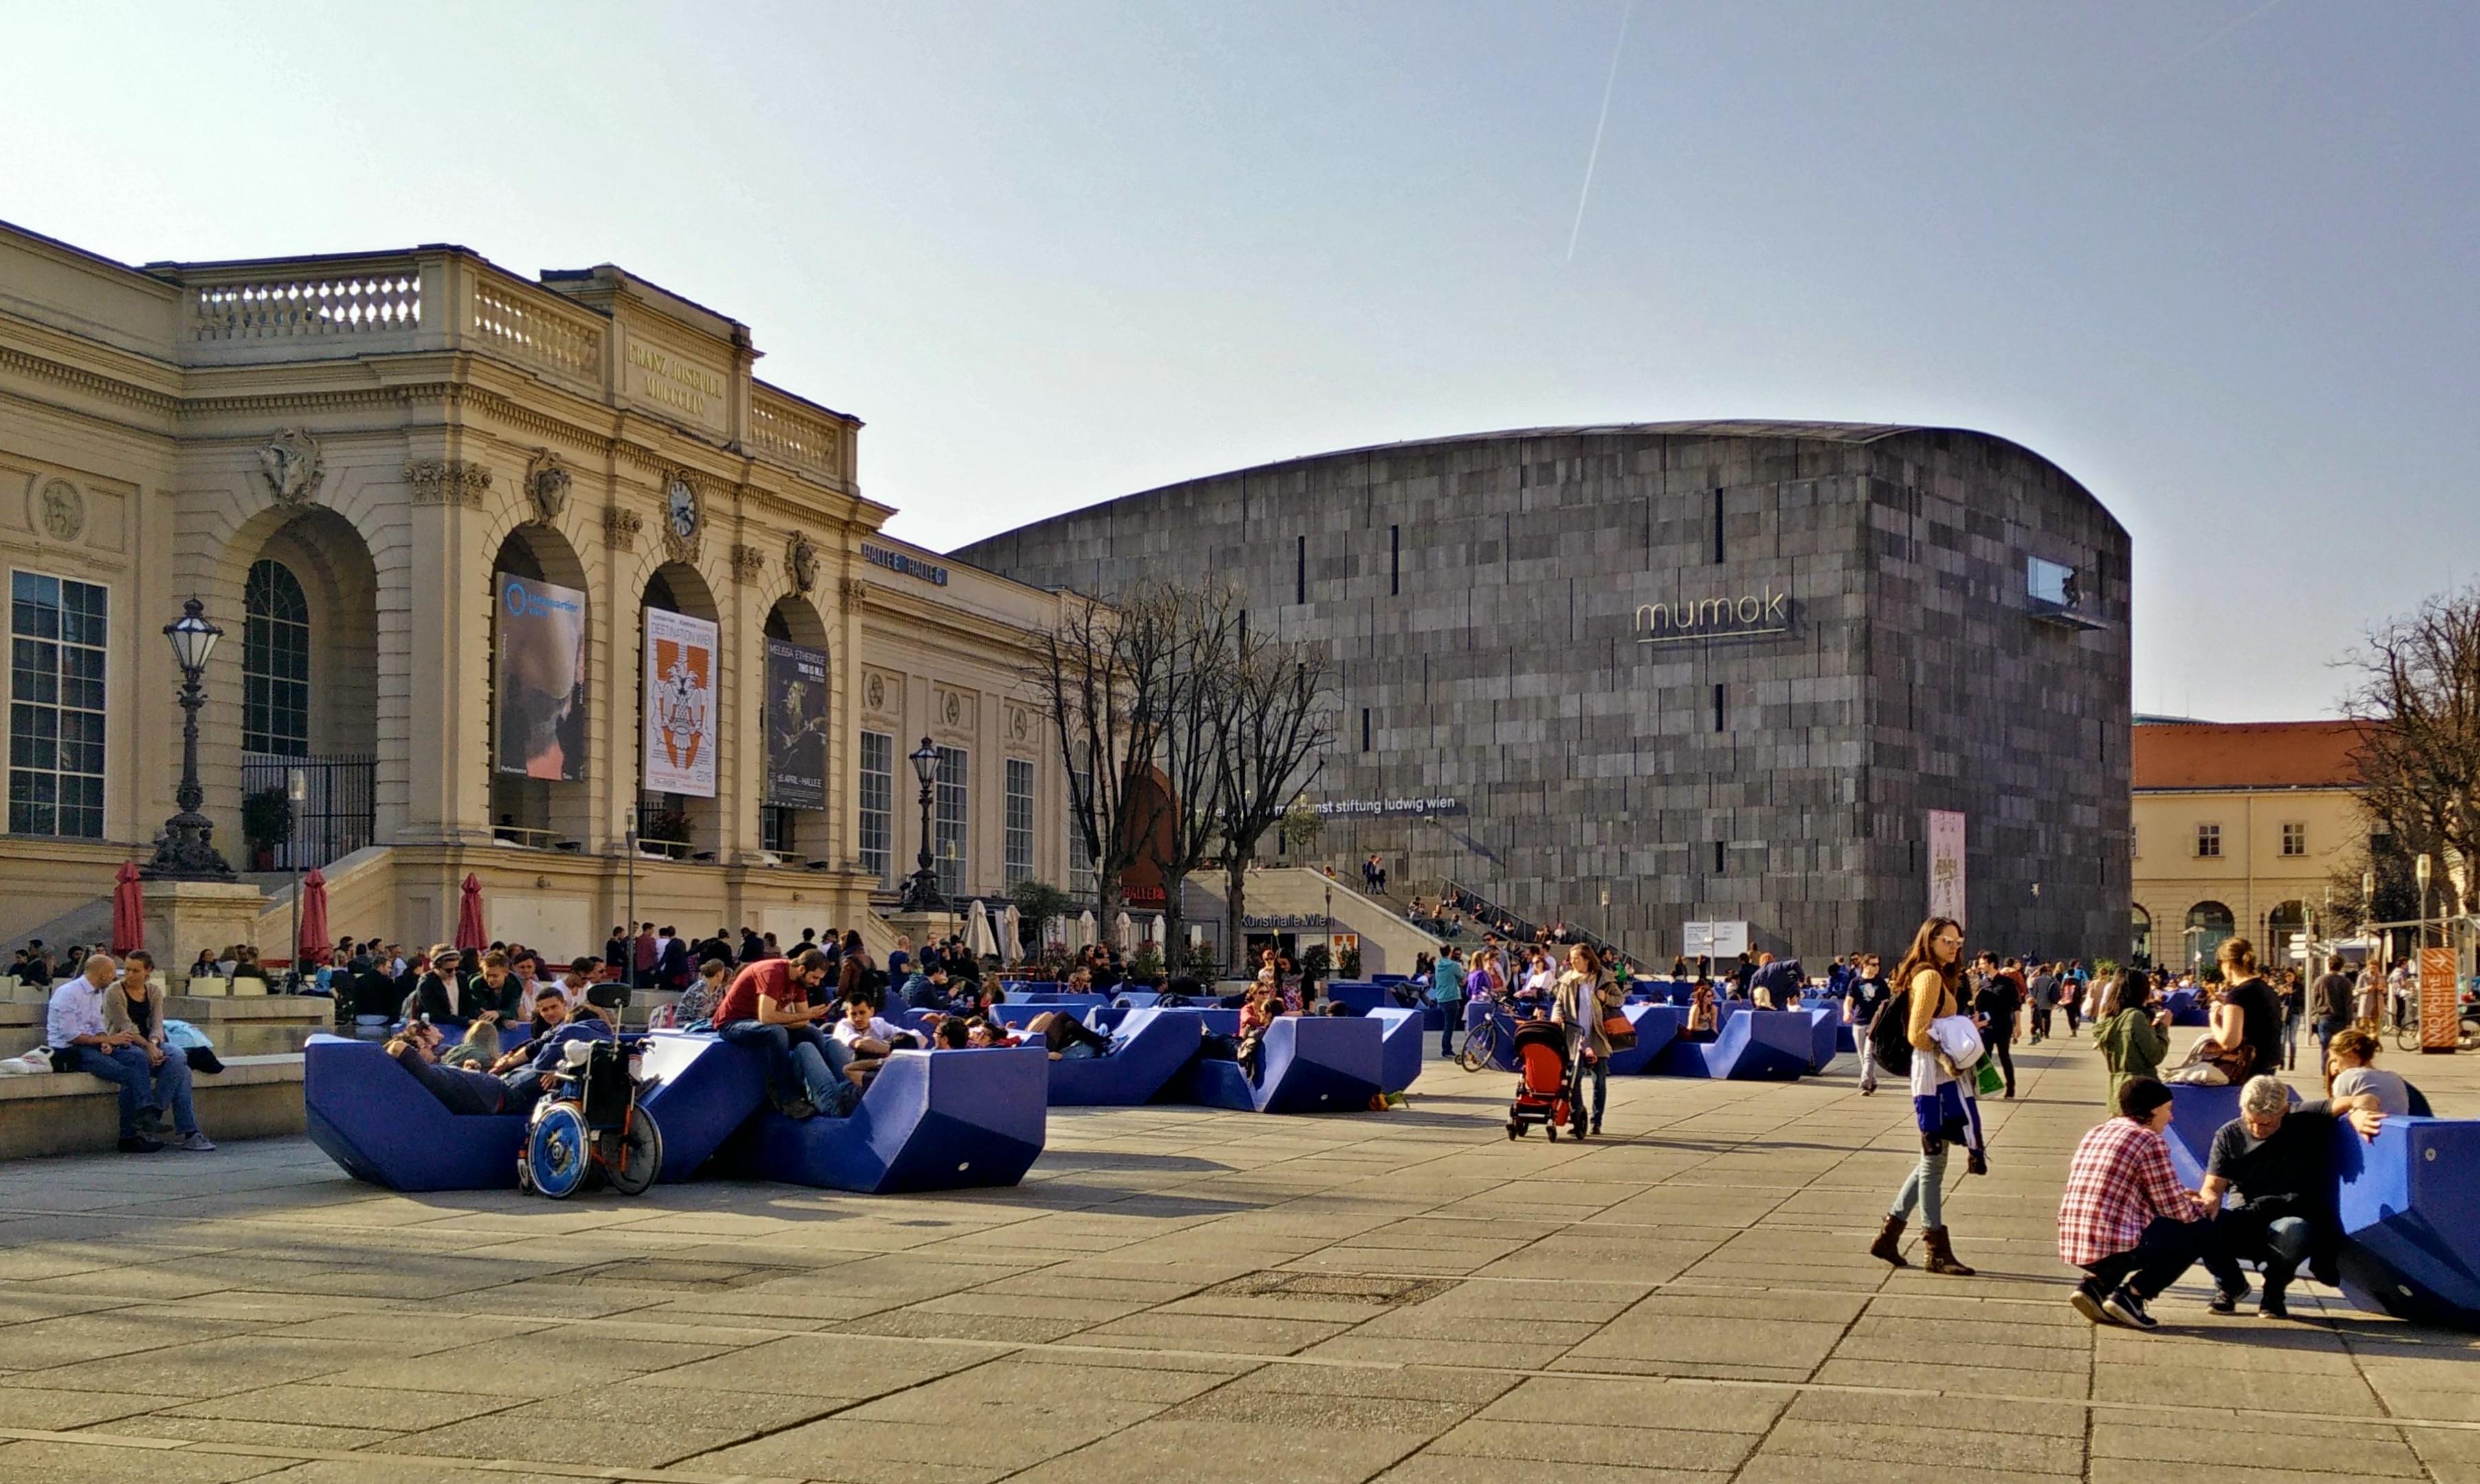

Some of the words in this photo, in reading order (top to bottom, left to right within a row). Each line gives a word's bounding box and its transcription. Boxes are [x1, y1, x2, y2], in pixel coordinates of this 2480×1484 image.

[627, 343, 667, 377] FRANZ
[645, 376, 704, 417] MDCCCLIV
[864, 544, 892, 569] HALLE
[894, 554, 900, 570] E
[908, 558, 935, 583] HALLE
[936, 568, 943, 584] G
[1636, 584, 1785, 632] mumok
[770, 643, 794, 658] MELISSA
[795, 649, 825, 666] ETHERIDGE
[1300, 801, 1334, 815] unst
[1336, 799, 1382, 814] stiftung
[1385, 795, 1424, 813] ludwig
[1426, 795, 1455, 809] wien
[1241, 912, 1301, 927] Kunsthalle
[2428, 976, 2442, 1013] Point
[2428, 1016, 2442, 1044] MQ
